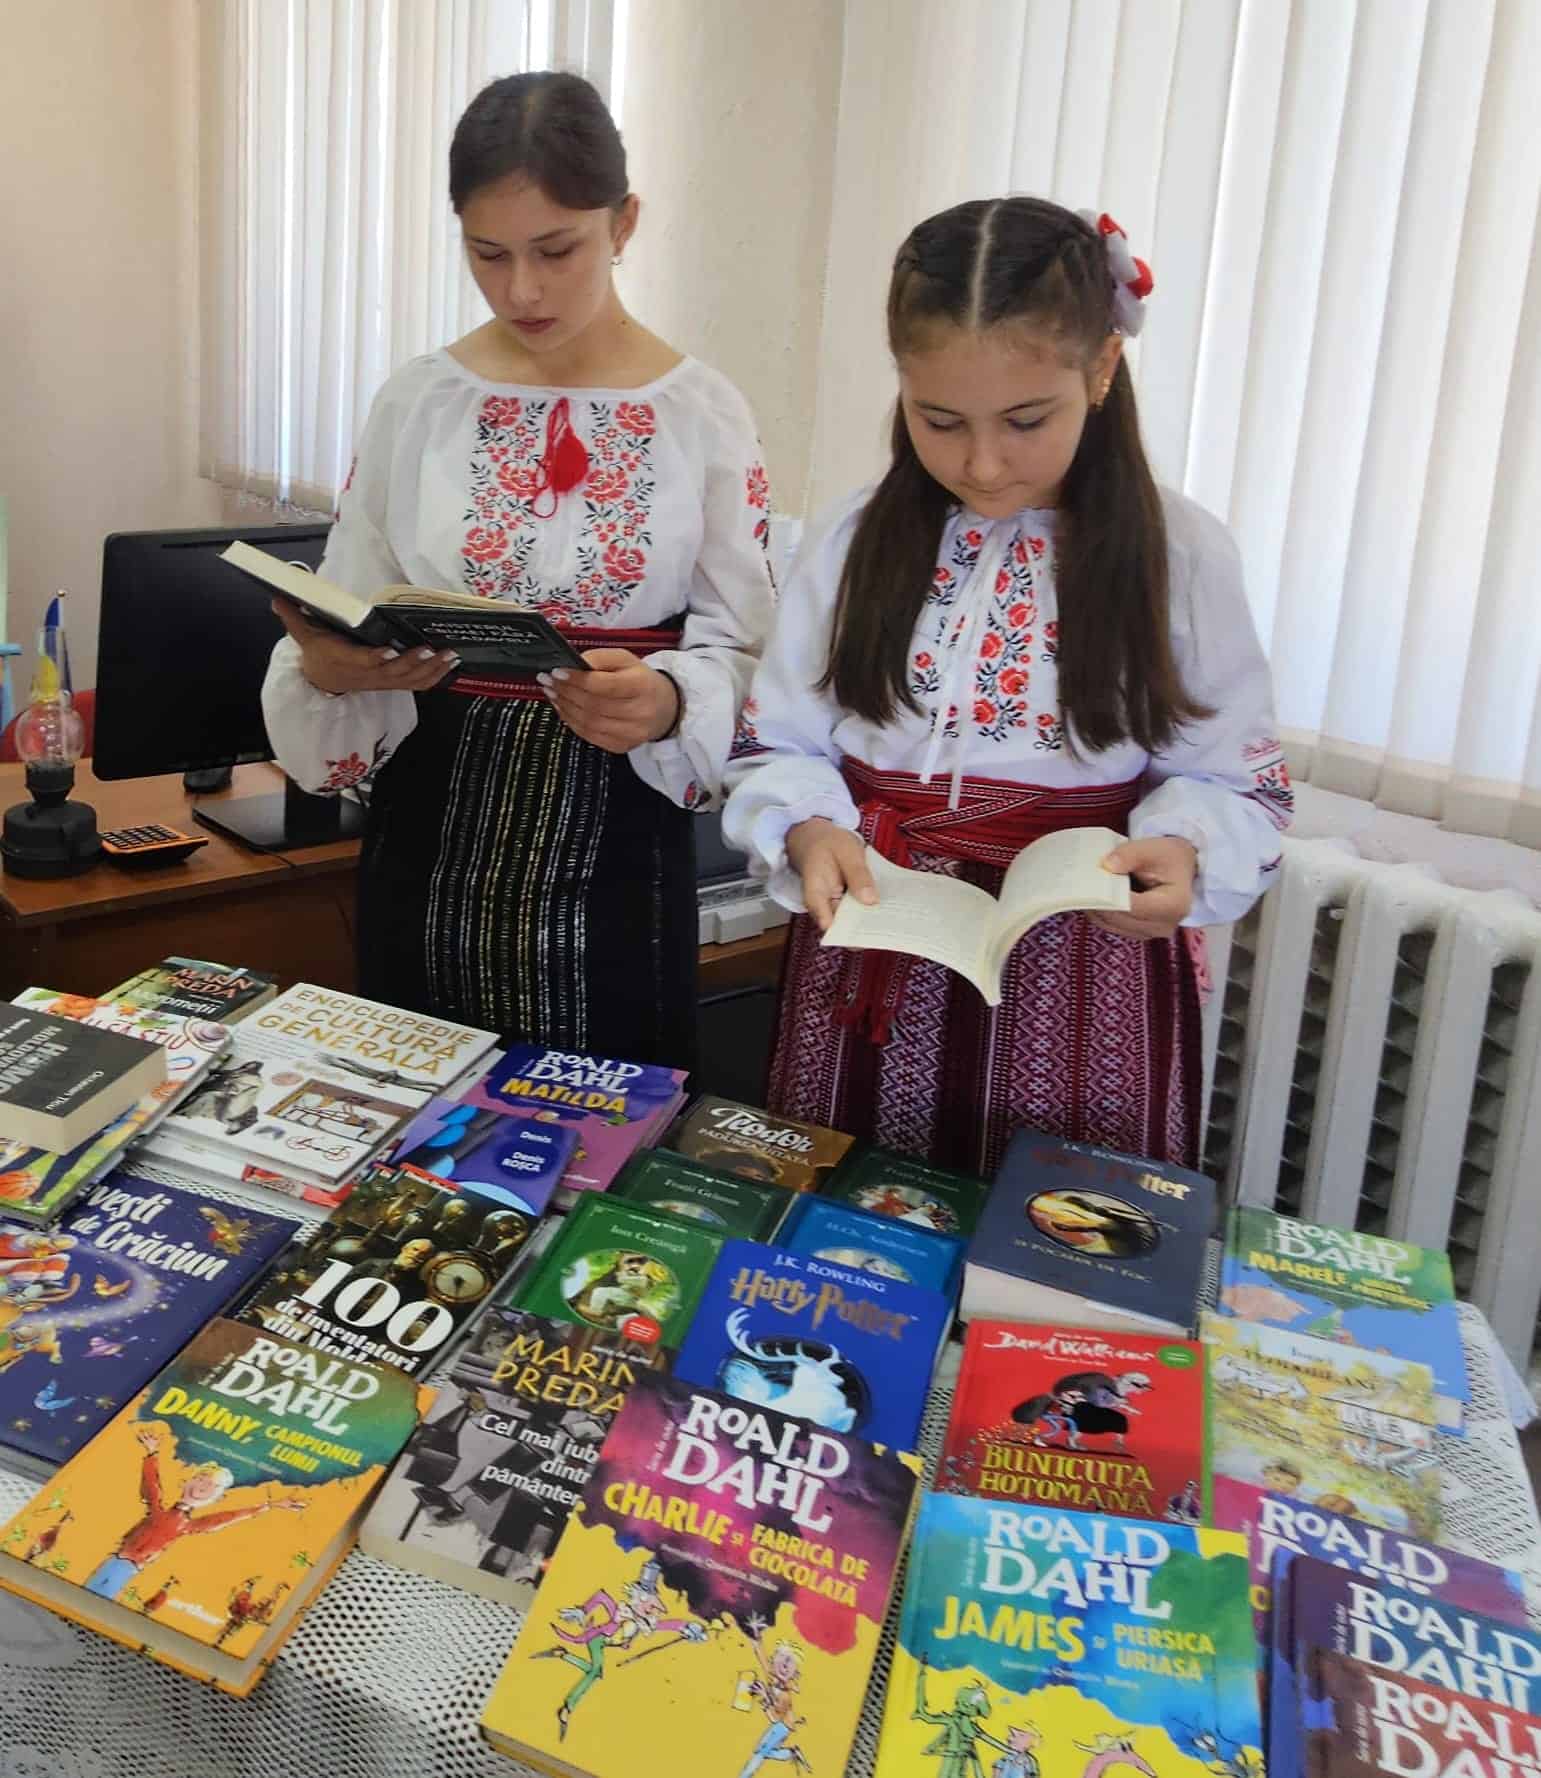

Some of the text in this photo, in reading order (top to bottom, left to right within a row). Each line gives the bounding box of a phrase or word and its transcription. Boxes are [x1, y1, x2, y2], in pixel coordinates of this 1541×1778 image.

[296, 990, 478, 1045] ENCICLOPEDIE
[500, 1077, 627, 1113] MATILDA
[525, 1062, 630, 1095] DAHL
[538, 1050, 645, 1077] ROALD
[70, 1215, 229, 1281] de Crăciun
[1275, 1216, 1409, 1262] ROALD
[1276, 1235, 1412, 1286] DAHL
[291, 1257, 454, 1352] 100
[729, 1267, 910, 1341] Harry Potter
[806, 1262, 886, 1293] ROWLING
[263, 1313, 306, 1342] din
[275, 1299, 421, 1373] de inventatori
[211, 1361, 352, 1436] DAHL
[237, 1337, 380, 1400] ROALD
[490, 1360, 626, 1414] PREDA
[264, 1424, 364, 1469] CAMPIONUL
[269, 1443, 321, 1474] LUMII
[479, 1413, 517, 1436] Cel
[519, 1429, 558, 1450] mai
[678, 1395, 850, 1479] ROALD
[662, 1432, 833, 1534] DAHL
[604, 1480, 734, 1545] CHARLIE
[751, 1523, 833, 1569] FABRICA
[841, 1553, 870, 1580] DE
[985, 1509, 1171, 1567] ROALD
[1256, 1496, 1450, 1586] ROALD
[980, 1546, 1173, 1619] DAHL
[933, 1595, 1086, 1663] JAMES
[1113, 1623, 1216, 1656] PIERSICA
[1347, 1582, 1541, 1677] ROALD
[1368, 1675, 1541, 1768] ROAL
